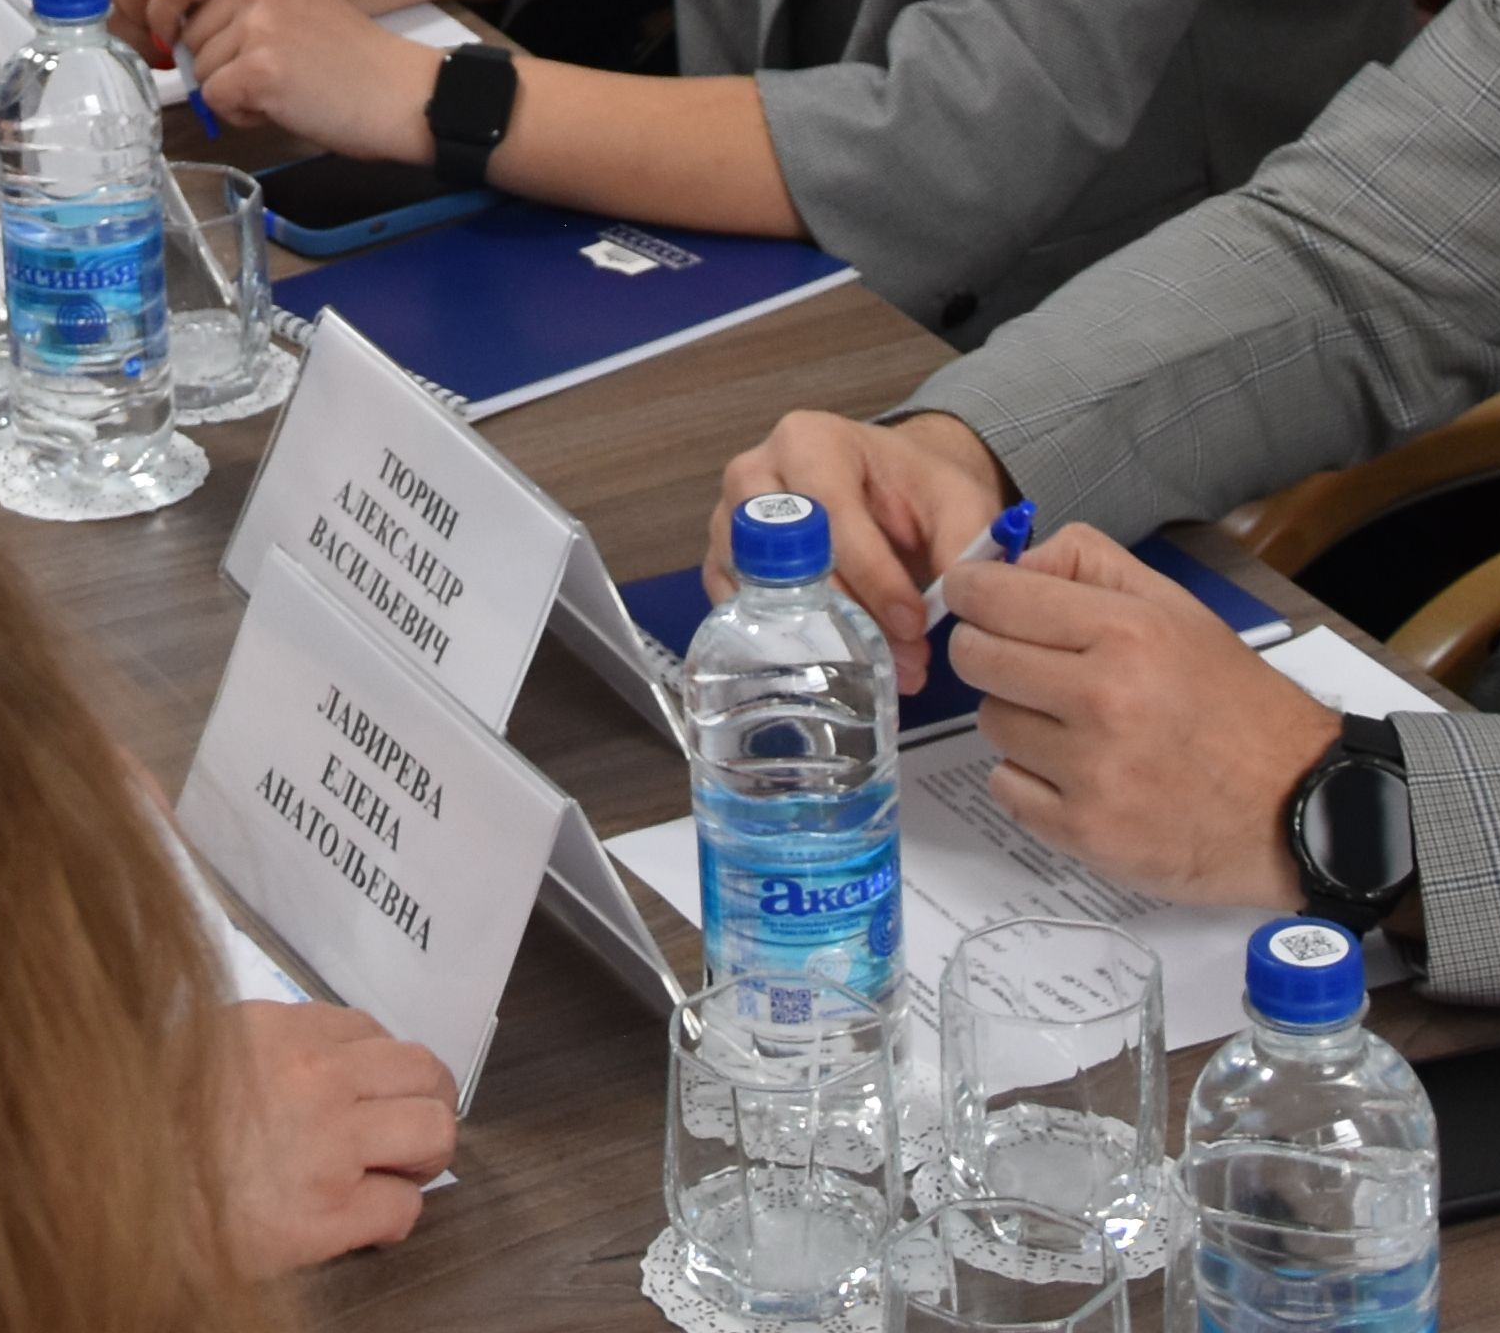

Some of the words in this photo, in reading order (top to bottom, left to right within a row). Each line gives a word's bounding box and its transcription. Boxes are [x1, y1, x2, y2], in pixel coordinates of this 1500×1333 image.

[333, 480, 464, 607] АЛЕКСАНДР
[379, 448, 459, 540] ТЮРИН
[308, 514, 450, 666] ВАСИЛЬЕВИЧ
[317, 684, 442, 821] ЛАВИРЕВА
[320, 753, 401, 852] ЕЛЕНА
[256, 767, 432, 953] АНАТОЛЬЕВНА
